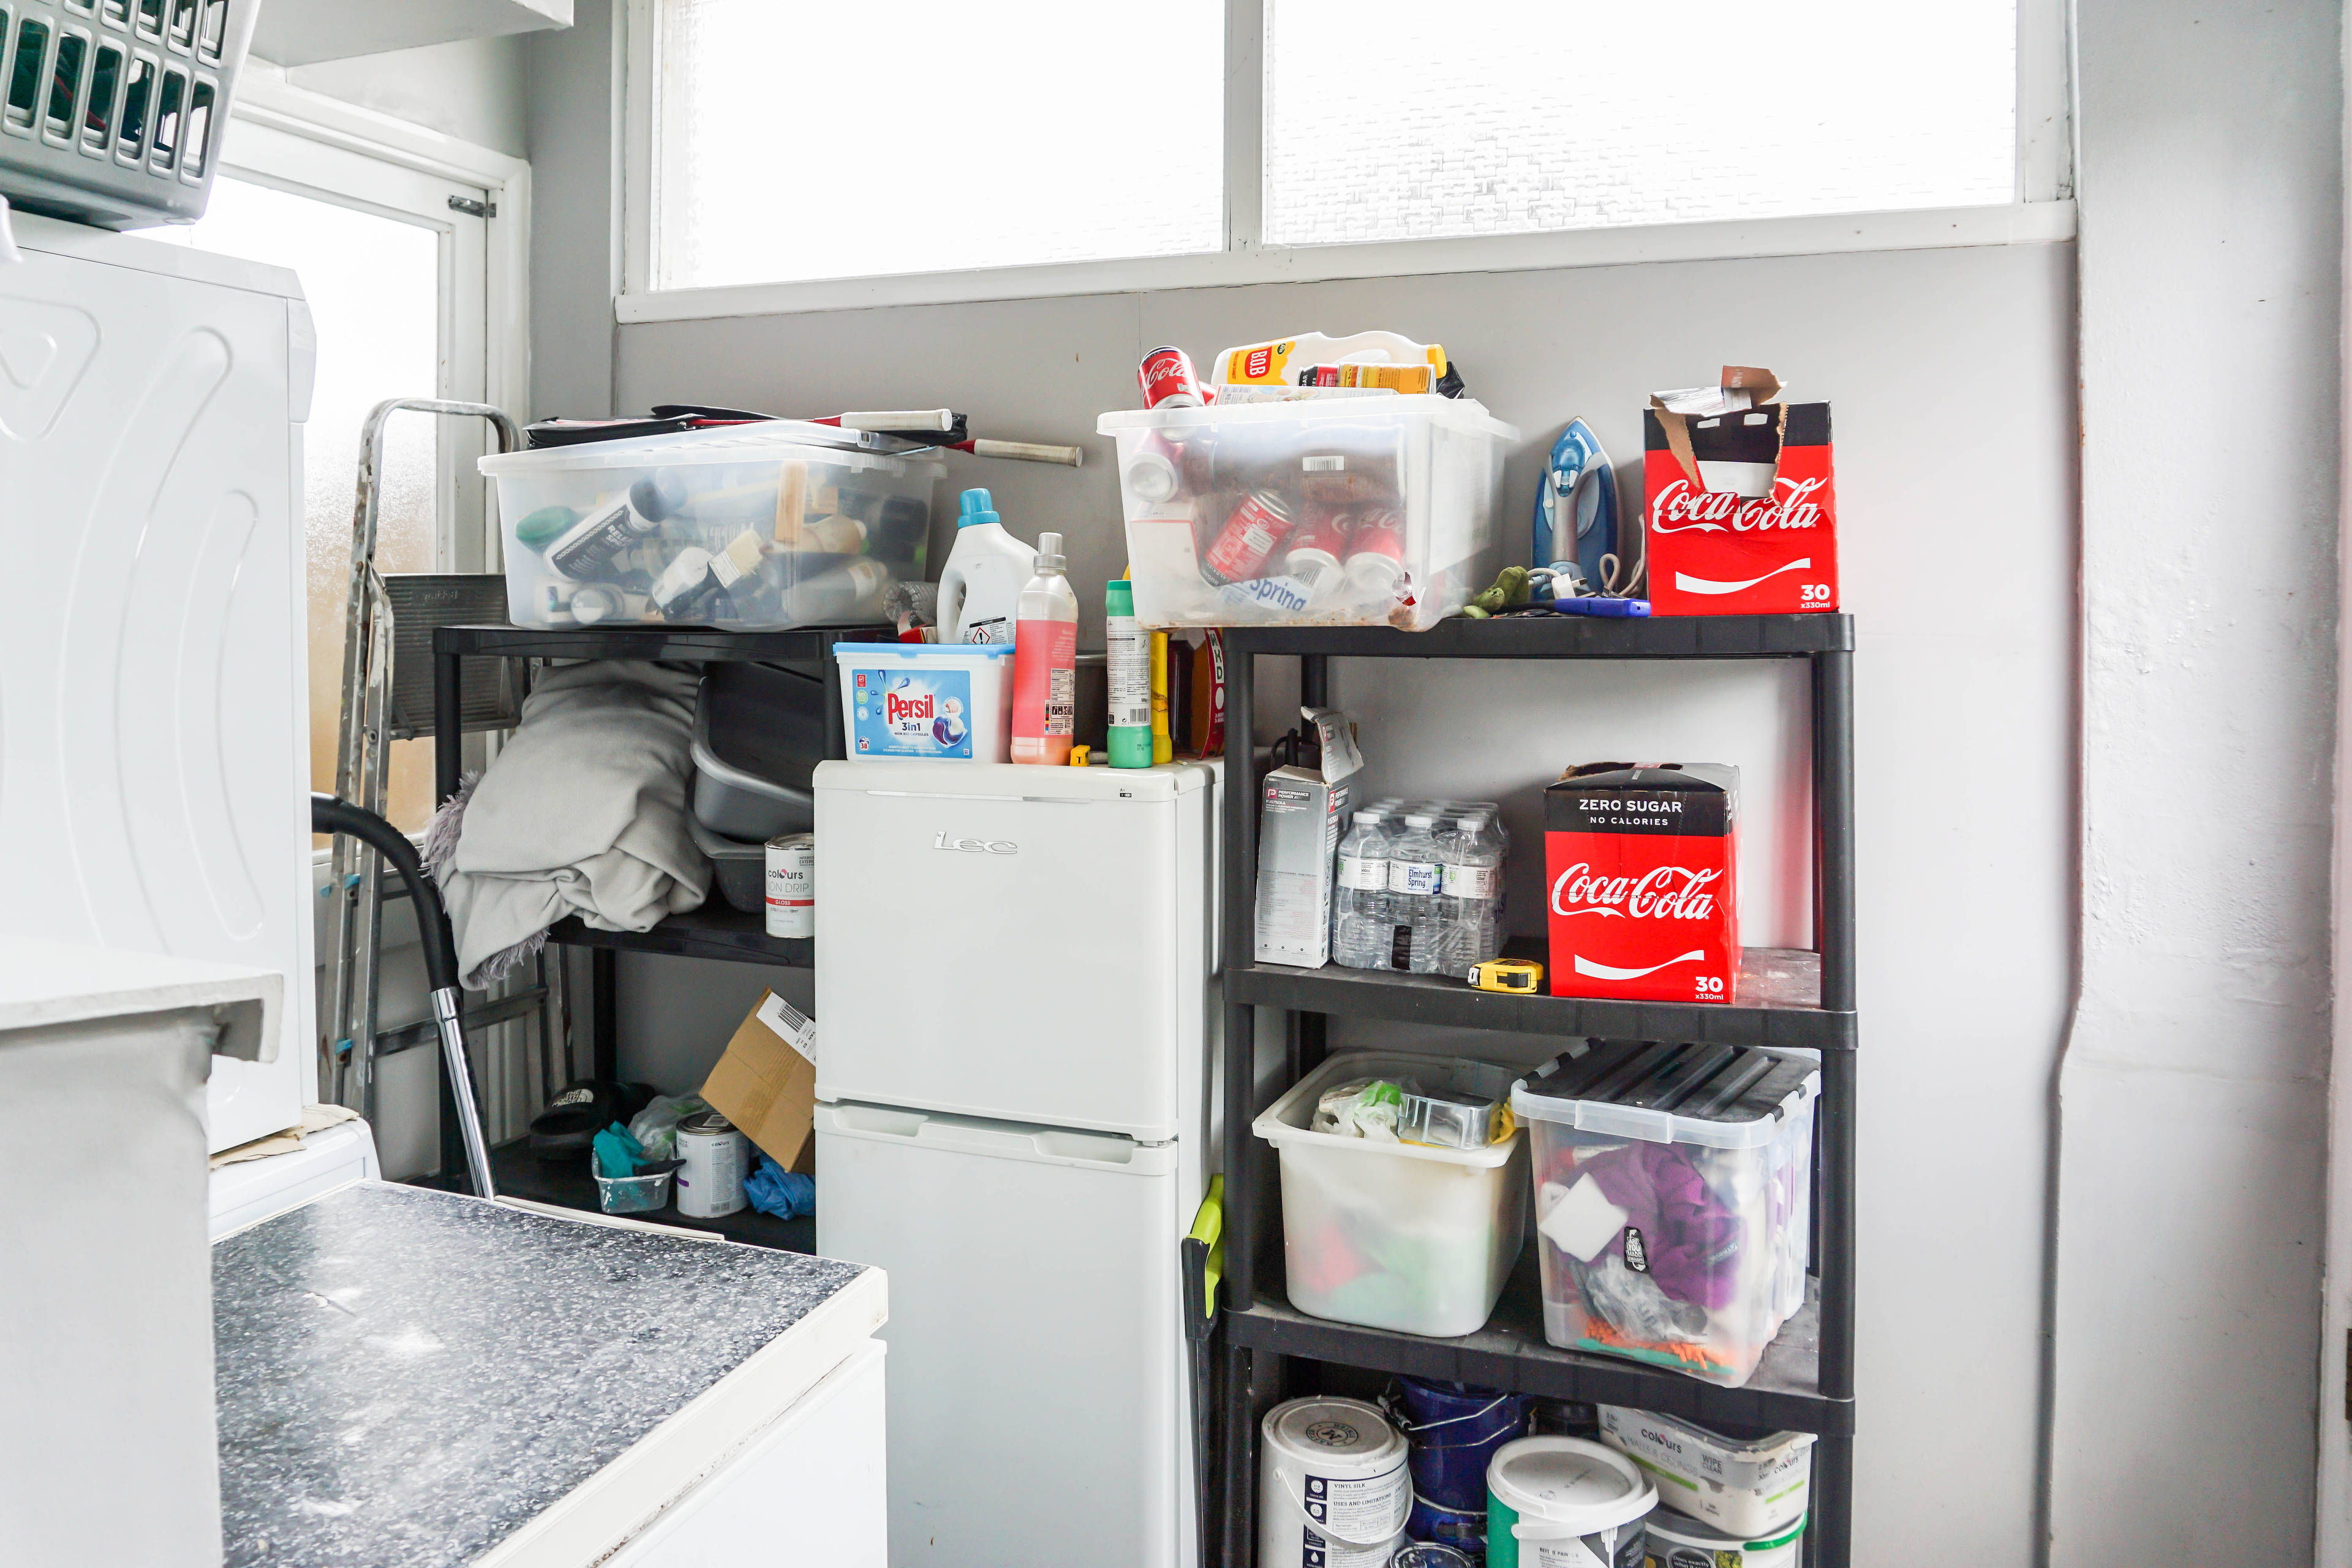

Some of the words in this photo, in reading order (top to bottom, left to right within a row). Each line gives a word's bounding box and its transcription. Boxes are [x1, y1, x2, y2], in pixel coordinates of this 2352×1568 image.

[1250, 350, 1268, 375] B.O.B
[1801, 584, 1830, 601] 30
[888, 693, 933, 724] Persil
[902, 722, 921, 731] 3in1
[1579, 799, 1621, 811] ZERO
[1626, 801, 1683, 813] SUGAR
[1611, 817, 1668, 826] CALORIES
[933, 831, 1017, 854] Lec
[768, 869, 804, 880] colours
[1409, 869, 1432, 878] Elmhurst
[785, 883, 809, 893] DRIP
[1408, 877, 1426, 888] Spring
[1551, 862, 1723, 919] Coca-Cola
[1695, 976, 1724, 992] 30
[1642, 1428, 1681, 1453] colours
[1362, 1492, 1392, 1505] LIMITATIONS
